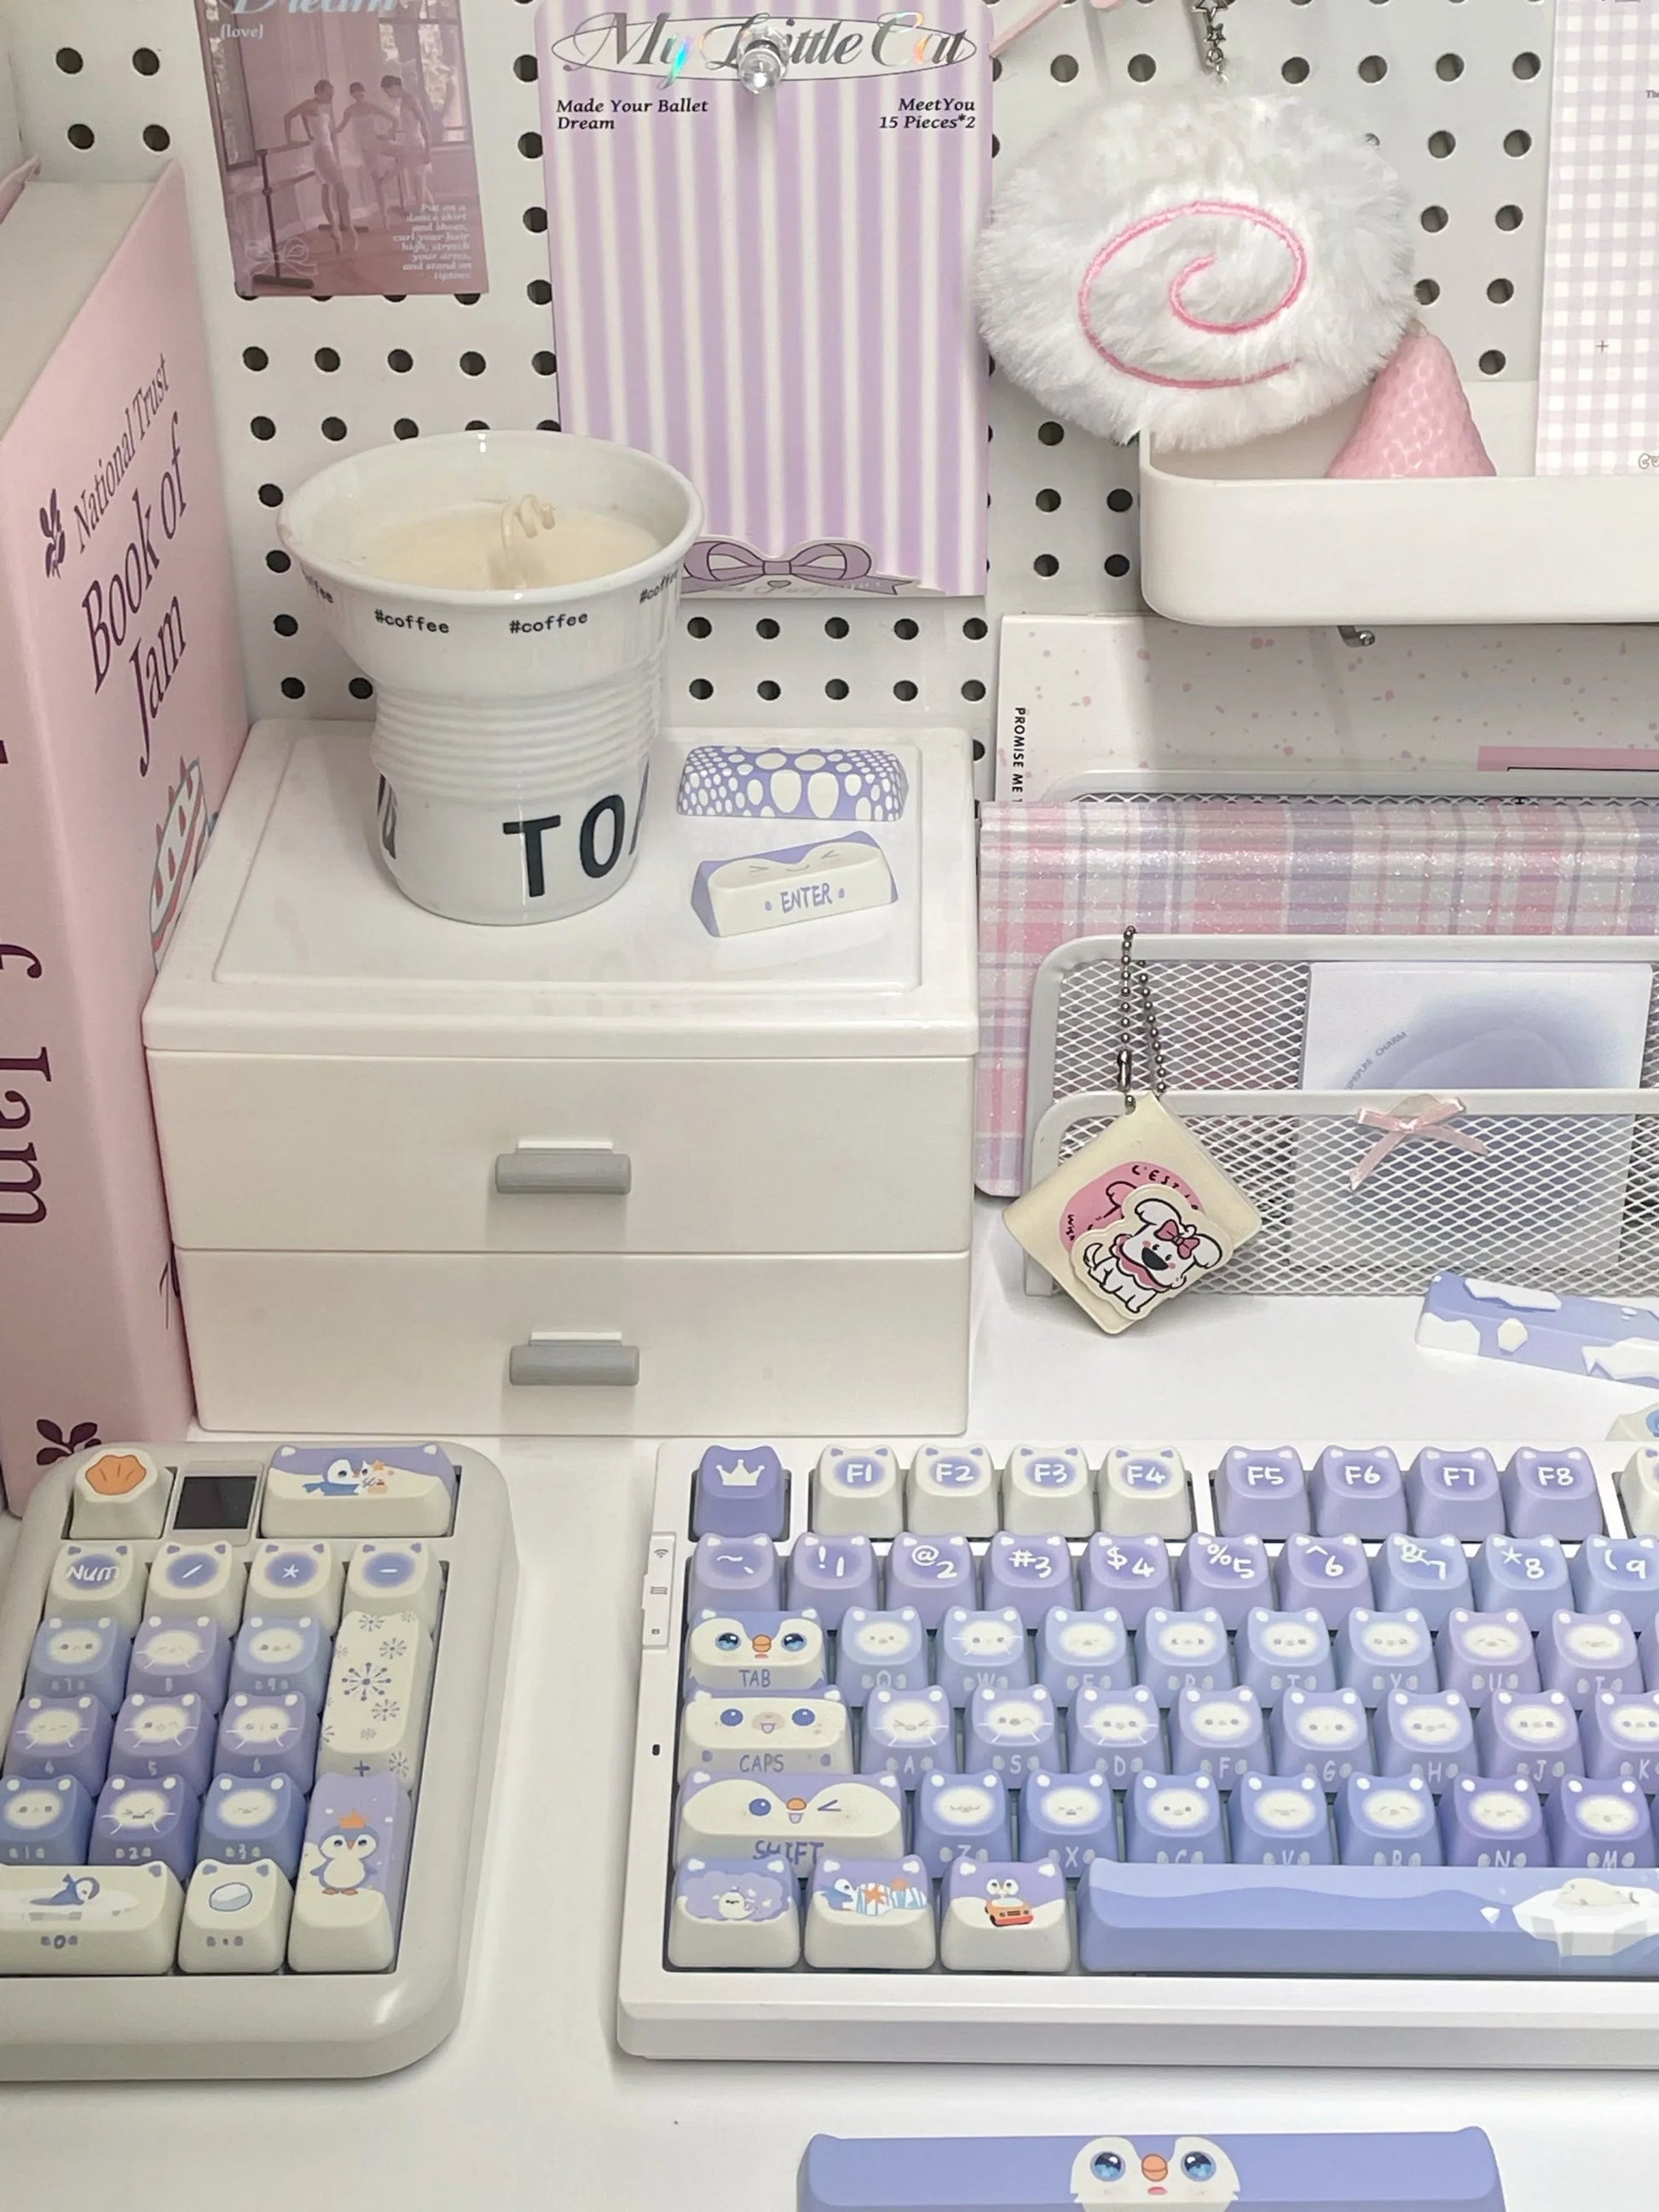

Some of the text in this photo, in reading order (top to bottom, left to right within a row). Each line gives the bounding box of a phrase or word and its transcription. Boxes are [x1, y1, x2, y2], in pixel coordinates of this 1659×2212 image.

[563, 11, 692, 90] My
[870, 11, 967, 66] Cat
[557, 97, 708, 113] Made Your Ballet
[557, 116, 616, 130] Dream
[879, 114, 900, 130] 15
[74, 352, 170, 554] National Trust
[82, 411, 188, 695] Book of
[374, 608, 449, 633] #coffee
[509, 612, 588, 633] #coffee
[130, 594, 188, 777] Jam
[1013, 707, 1026, 769] PROMISE
[1011, 772, 1023, 794] ME
[780, 882, 833, 914] ENTER
[1374, 1030, 1408, 1057] CHARM
[846, 1464, 873, 1483] F1
[935, 1464, 975, 1482] F2
[1033, 1463, 1068, 1483] F3
[1126, 1465, 1166, 1485] F4
[1246, 1465, 1285, 1486] F5
[1344, 1464, 1381, 1485] F6
[1442, 1466, 1477, 1486] F7
[1537, 1466, 1575, 1486] F8
[738, 1668, 771, 1689] TAB
[739, 1753, 784, 1773] CAPS
[904, 1755, 916, 1775] A
[1010, 1754, 1022, 1775] S
[1114, 1755, 1126, 1776] D
[1219, 1757, 1230, 1779] F
[1323, 1760, 1336, 1782] G
[1428, 1761, 1442, 1783] H
[1534, 1759, 1547, 1782] J
[1639, 1759, 1656, 1780] K
[753, 1839, 824, 1865] SHIFT
[1064, 1845, 1078, 1867] X
[1494, 1850, 1511, 1868] N
[1602, 1849, 1619, 1868] M
